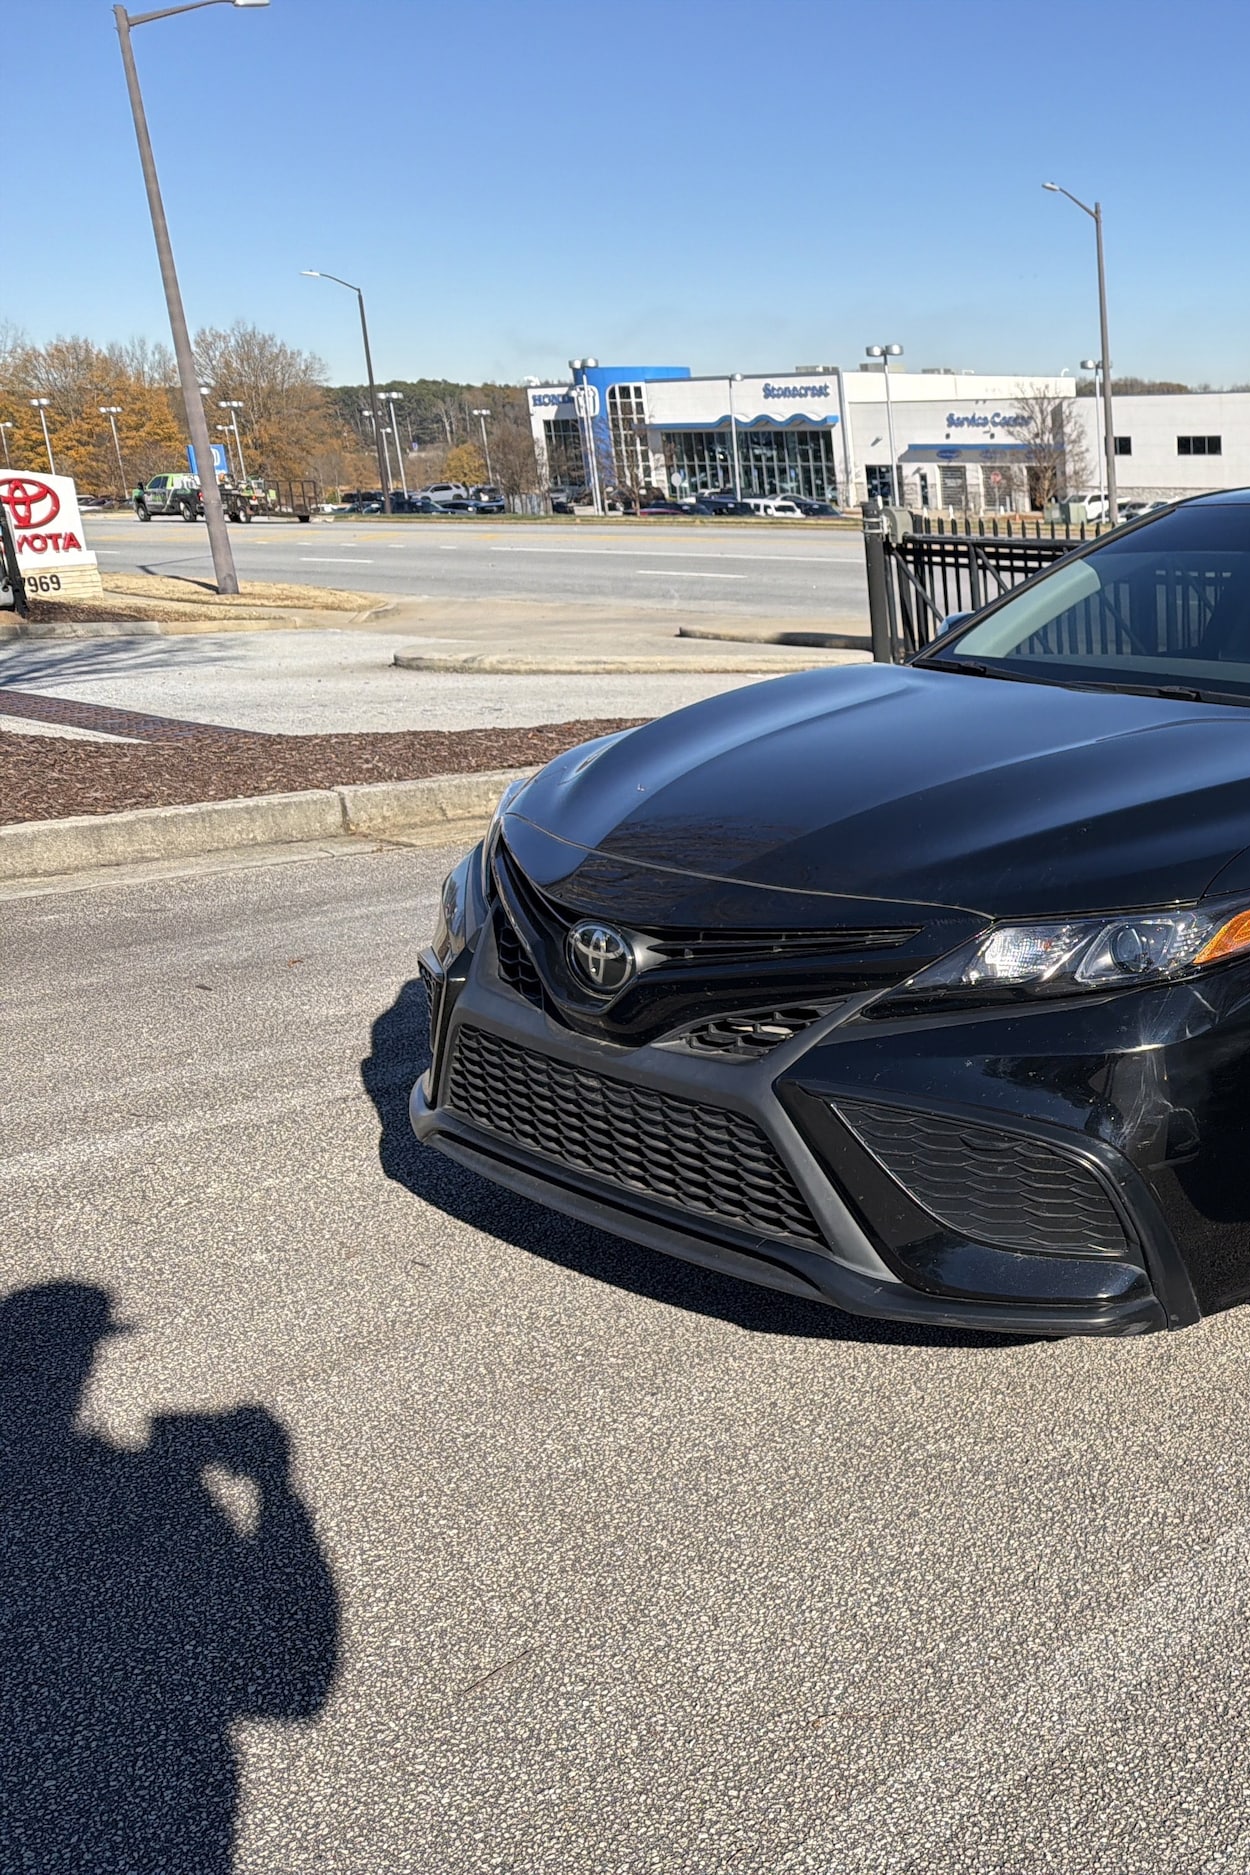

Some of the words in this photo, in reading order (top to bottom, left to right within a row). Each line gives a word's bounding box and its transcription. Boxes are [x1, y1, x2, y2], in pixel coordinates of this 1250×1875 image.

[762, 381, 831, 400] Stonecrest
[946, 412, 990, 428] Service
[16, 531, 82, 555] YOTA
